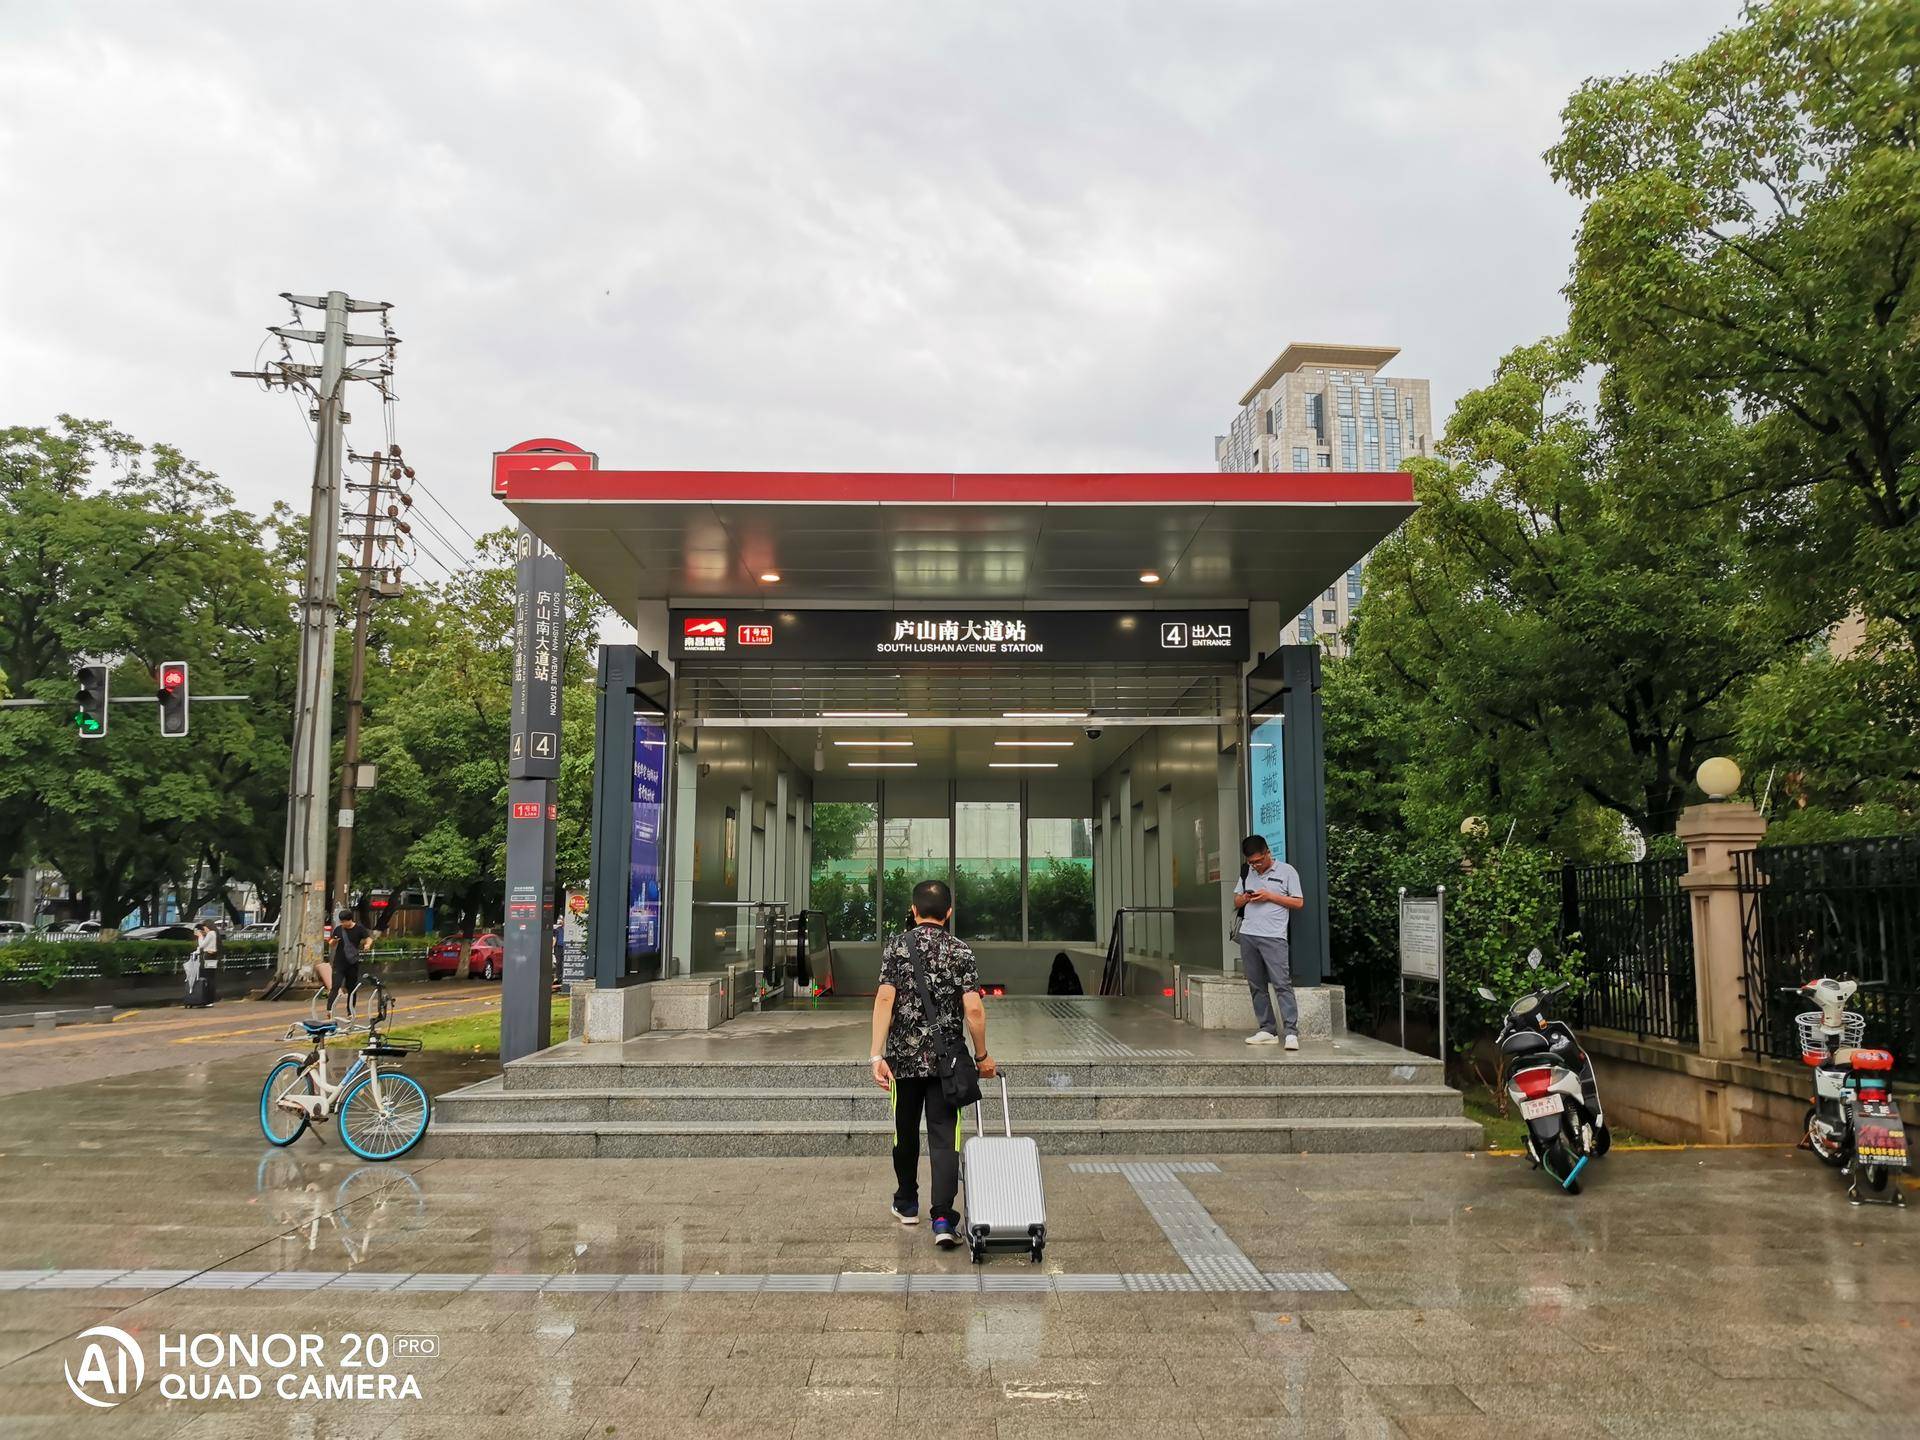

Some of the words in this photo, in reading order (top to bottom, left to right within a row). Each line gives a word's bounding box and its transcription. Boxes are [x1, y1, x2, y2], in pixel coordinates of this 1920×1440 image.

[534, 590, 551, 680] 庐山南大道站
[552, 622, 560, 651] LUSHAN
[893, 620, 1026, 641] 庐山南大道站
[1166, 625, 1182, 645] 4
[1192, 624, 1231, 638] 出入口
[684, 637, 725, 647] 南昌地铁
[877, 643, 912, 652] SOUTH
[914, 643, 955, 652] LUSHAN
[956, 643, 996, 652] AVENUE
[1001, 643, 1043, 652] STATION
[550, 655, 558, 684] AVENUE
[549, 686, 557, 716] STATION
[513, 736, 521, 756] 4
[536, 736, 550, 756] 4
